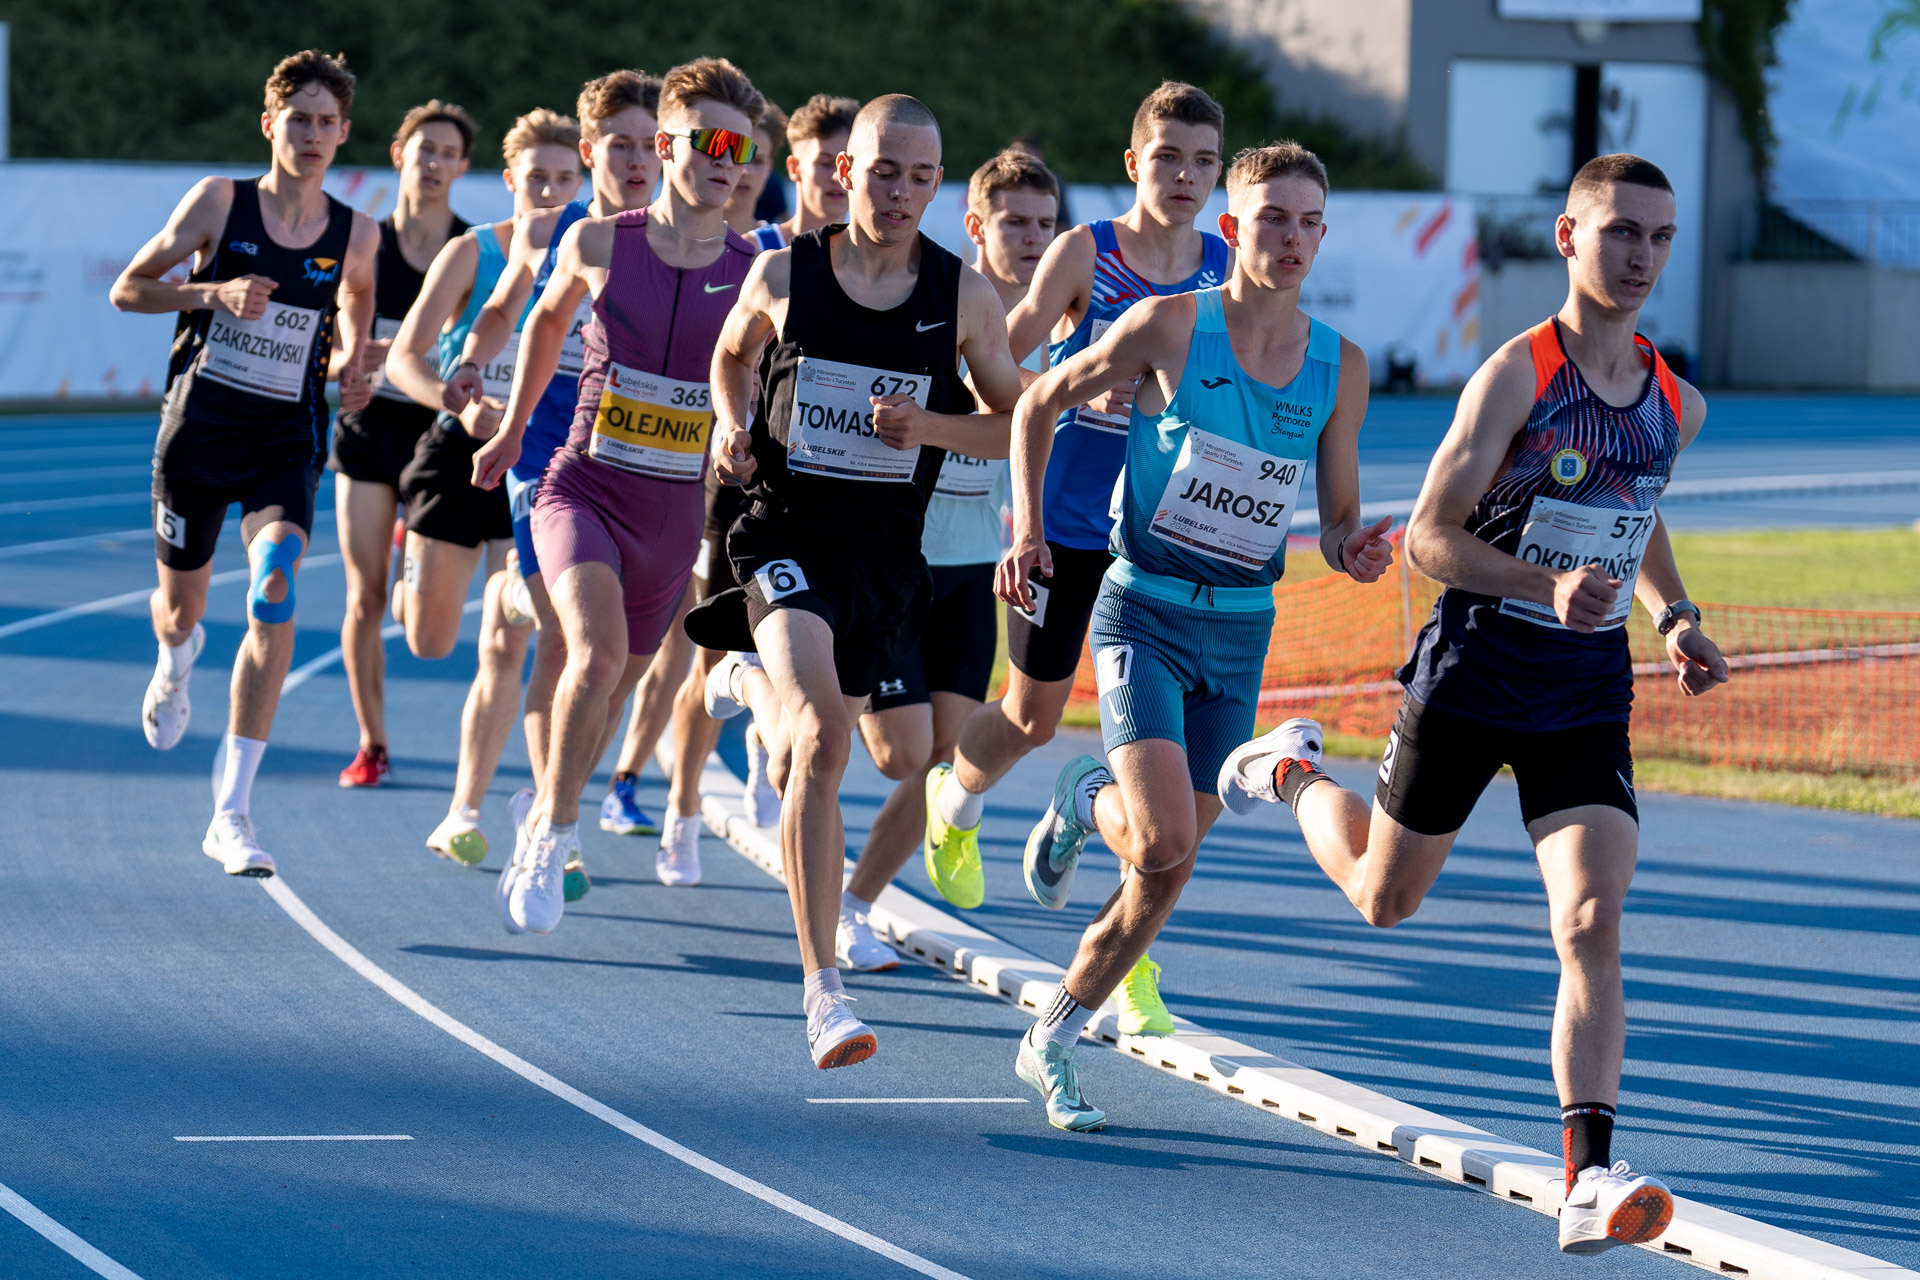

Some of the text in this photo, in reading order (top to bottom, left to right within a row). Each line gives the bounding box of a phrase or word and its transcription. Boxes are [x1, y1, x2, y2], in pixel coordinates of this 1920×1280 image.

[275, 309, 310, 331] 602
[210, 322, 304, 365] ZAKRZEWSKI
[816, 374, 832, 382] Sportu
[835, 377, 857, 387] Turystyki
[817, 368, 848, 379] Ministerstwo
[870, 374, 919, 400] 672
[670, 387, 709, 407] 365
[1275, 400, 1313, 418] WMLKS
[607, 406, 704, 443] OLEJNIK
[798, 401, 880, 439] TOMAS
[1271, 411, 1311, 428] Pomorze
[606, 439, 645, 455] LUBELSKIE
[800, 452, 821, 461] 2024
[802, 444, 846, 457] LUBELSKIE
[1205, 442, 1237, 458] Ministerstwo
[1203, 448, 1220, 459] Sportu
[1222, 455, 1244, 467] Turystyki
[1257, 459, 1297, 486] 940
[1179, 477, 1286, 528] JAROSZ
[162, 511, 176, 539] 5
[1173, 513, 1218, 535] LUBELSKIE
[1553, 517, 1571, 526] Sportu
[1575, 521, 1598, 531] Turystyki
[1555, 511, 1590, 523] Ministerstwo
[1169, 520, 1192, 534] 2024
[1171, 532, 1194, 545] LUBLIN
[768, 562, 797, 593] 6
[1113, 651, 1128, 679] 1
